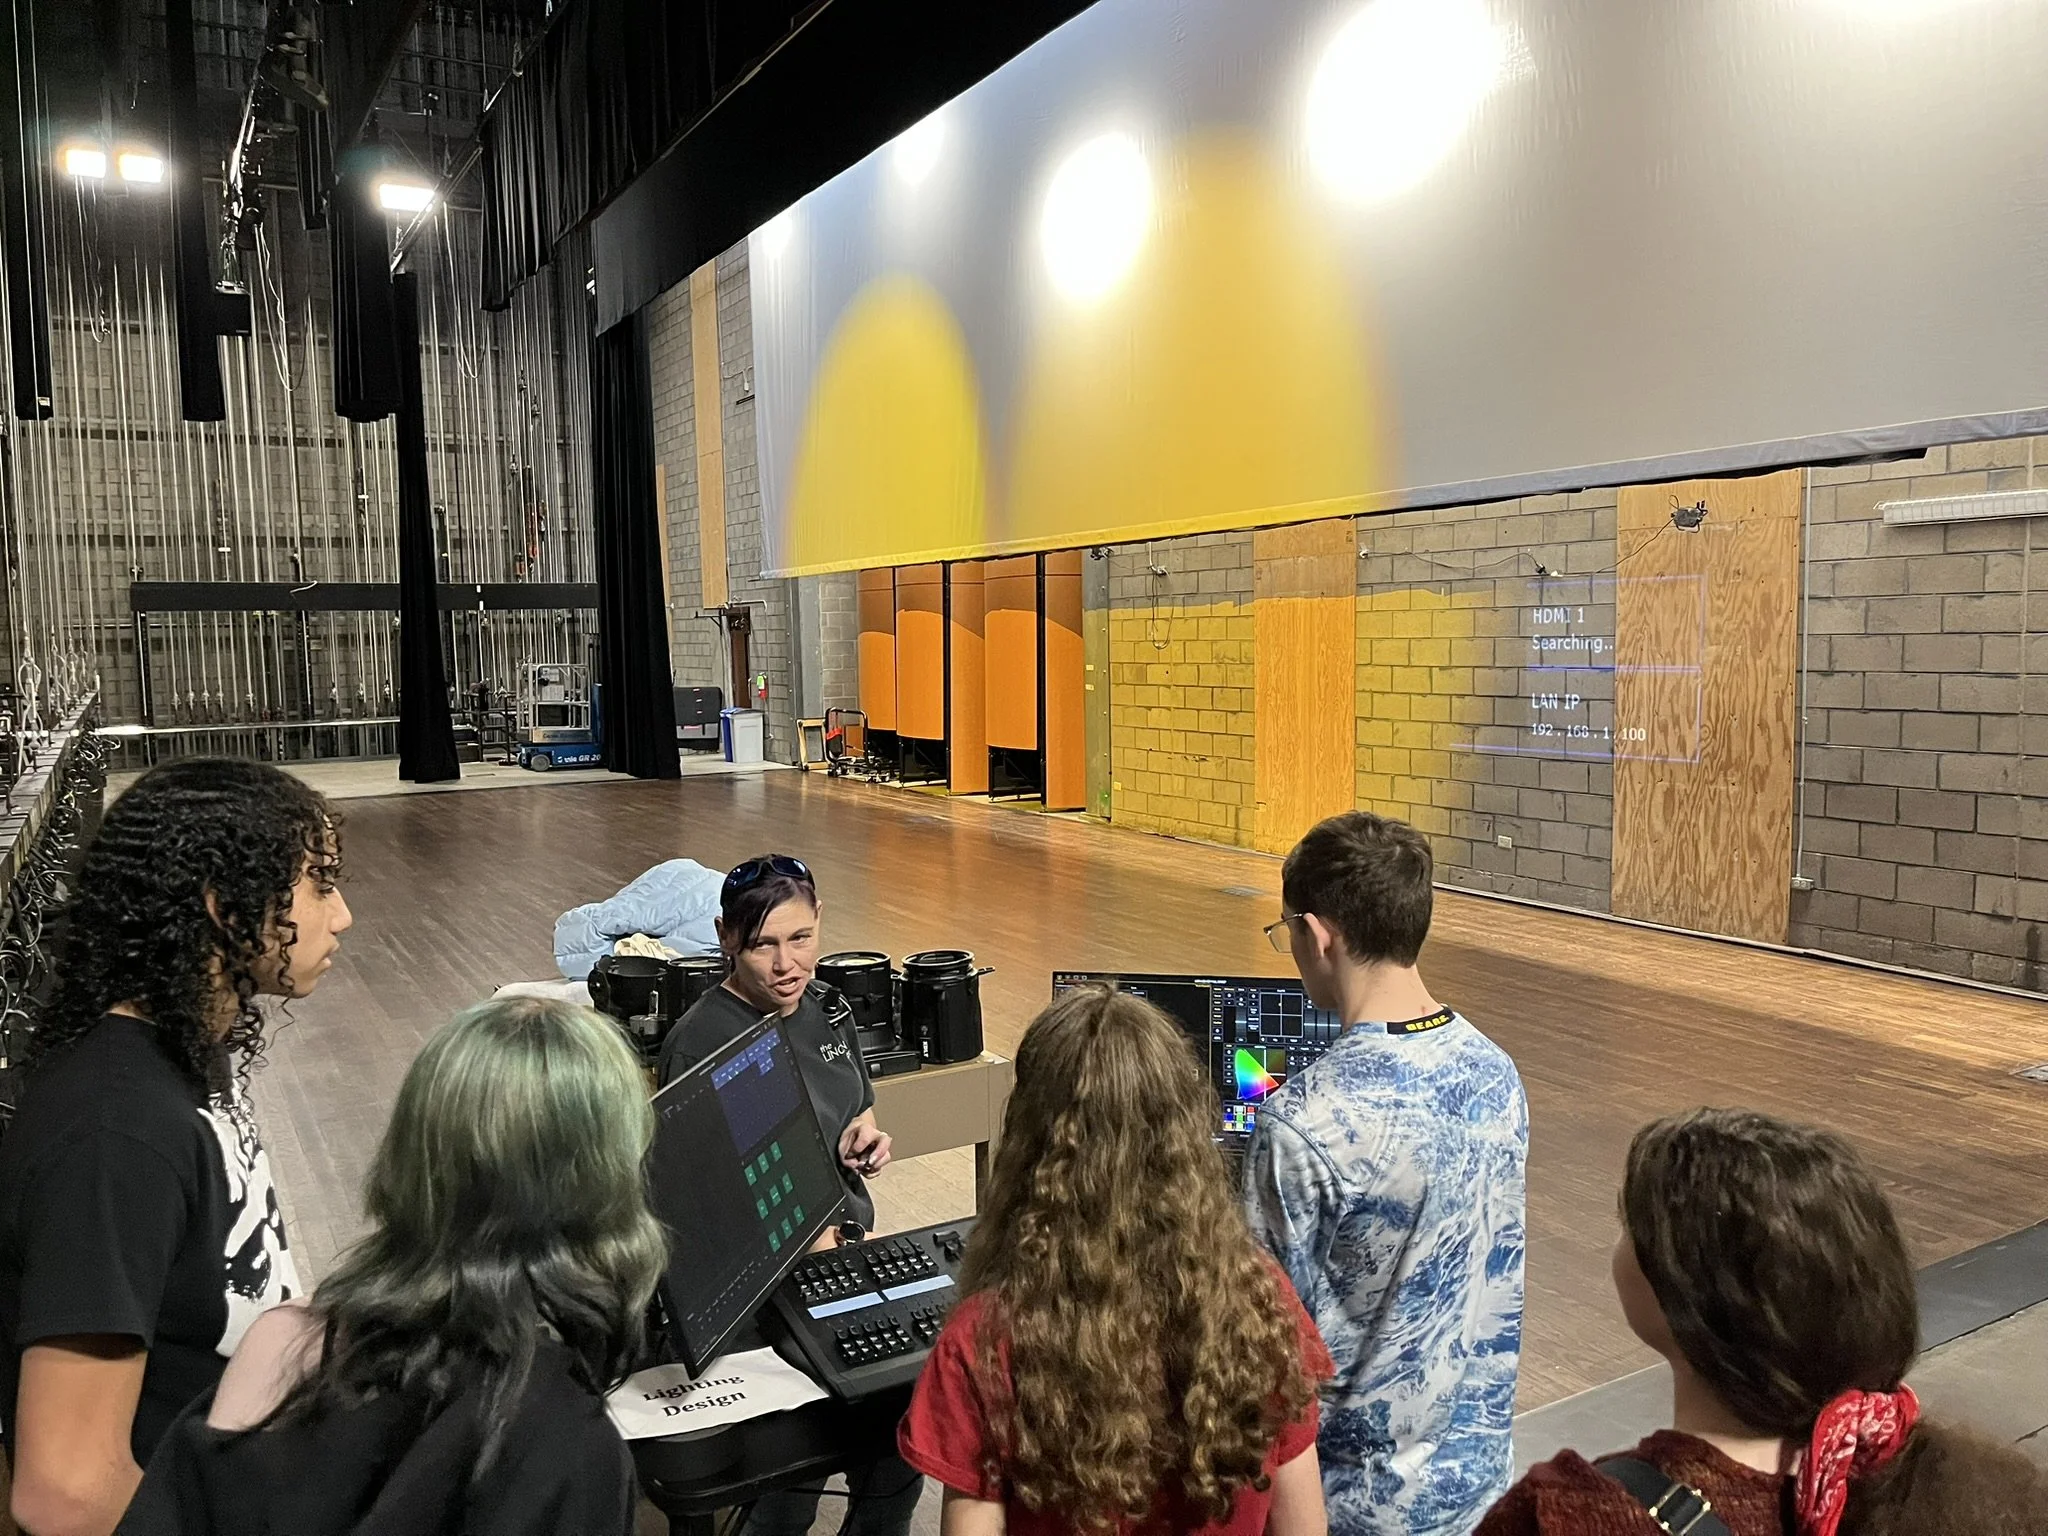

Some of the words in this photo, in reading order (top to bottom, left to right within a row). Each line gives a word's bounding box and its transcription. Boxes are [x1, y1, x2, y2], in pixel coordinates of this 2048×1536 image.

[1533, 607, 1571, 624] HDMI
[1577, 607, 1584, 623] 1
[1532, 692, 1558, 710] LAN
[1564, 694, 1580, 710] IP
[642, 1376, 744, 1401] Lighting
[662, 1392, 746, 1417] Design
